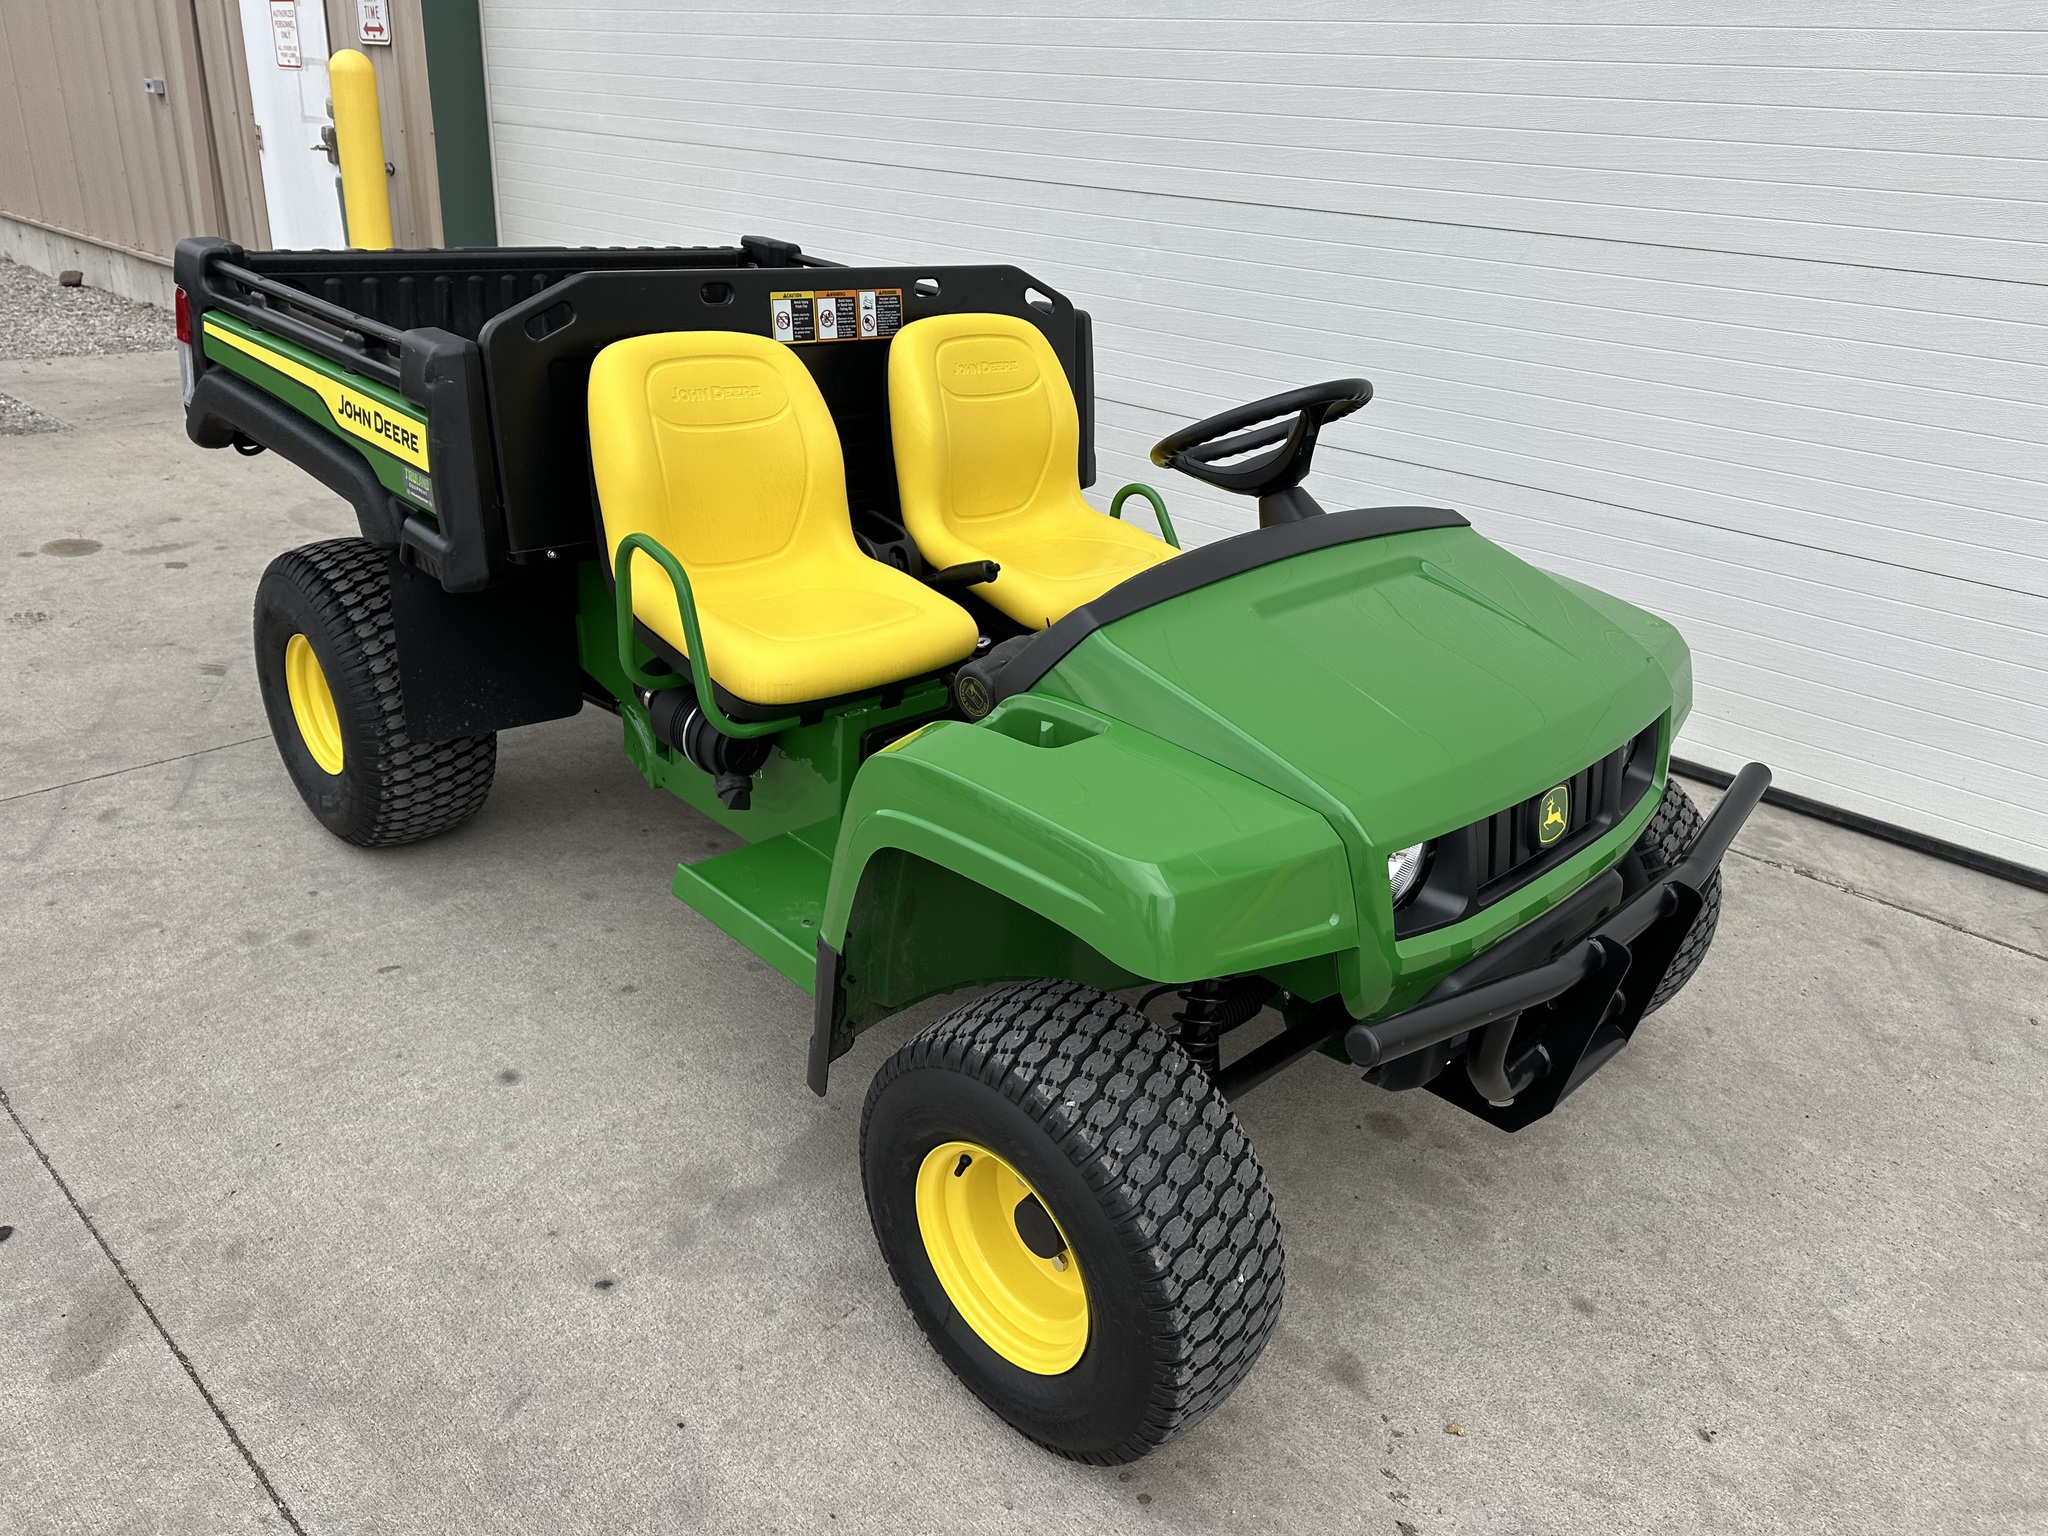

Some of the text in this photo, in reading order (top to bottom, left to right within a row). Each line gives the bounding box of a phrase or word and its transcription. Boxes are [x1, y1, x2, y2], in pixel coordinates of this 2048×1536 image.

[273, 9, 294, 18] AUTHORIZED
[364, 6, 380, 19] TIME
[274, 20, 295, 29] PERSONNEL
[281, 31, 291, 39] ONLY
[953, 361, 1019, 376] JOHN DEERE
[672, 385, 762, 402] JOHN DEERE
[338, 394, 419, 453] JOHN DEERE
